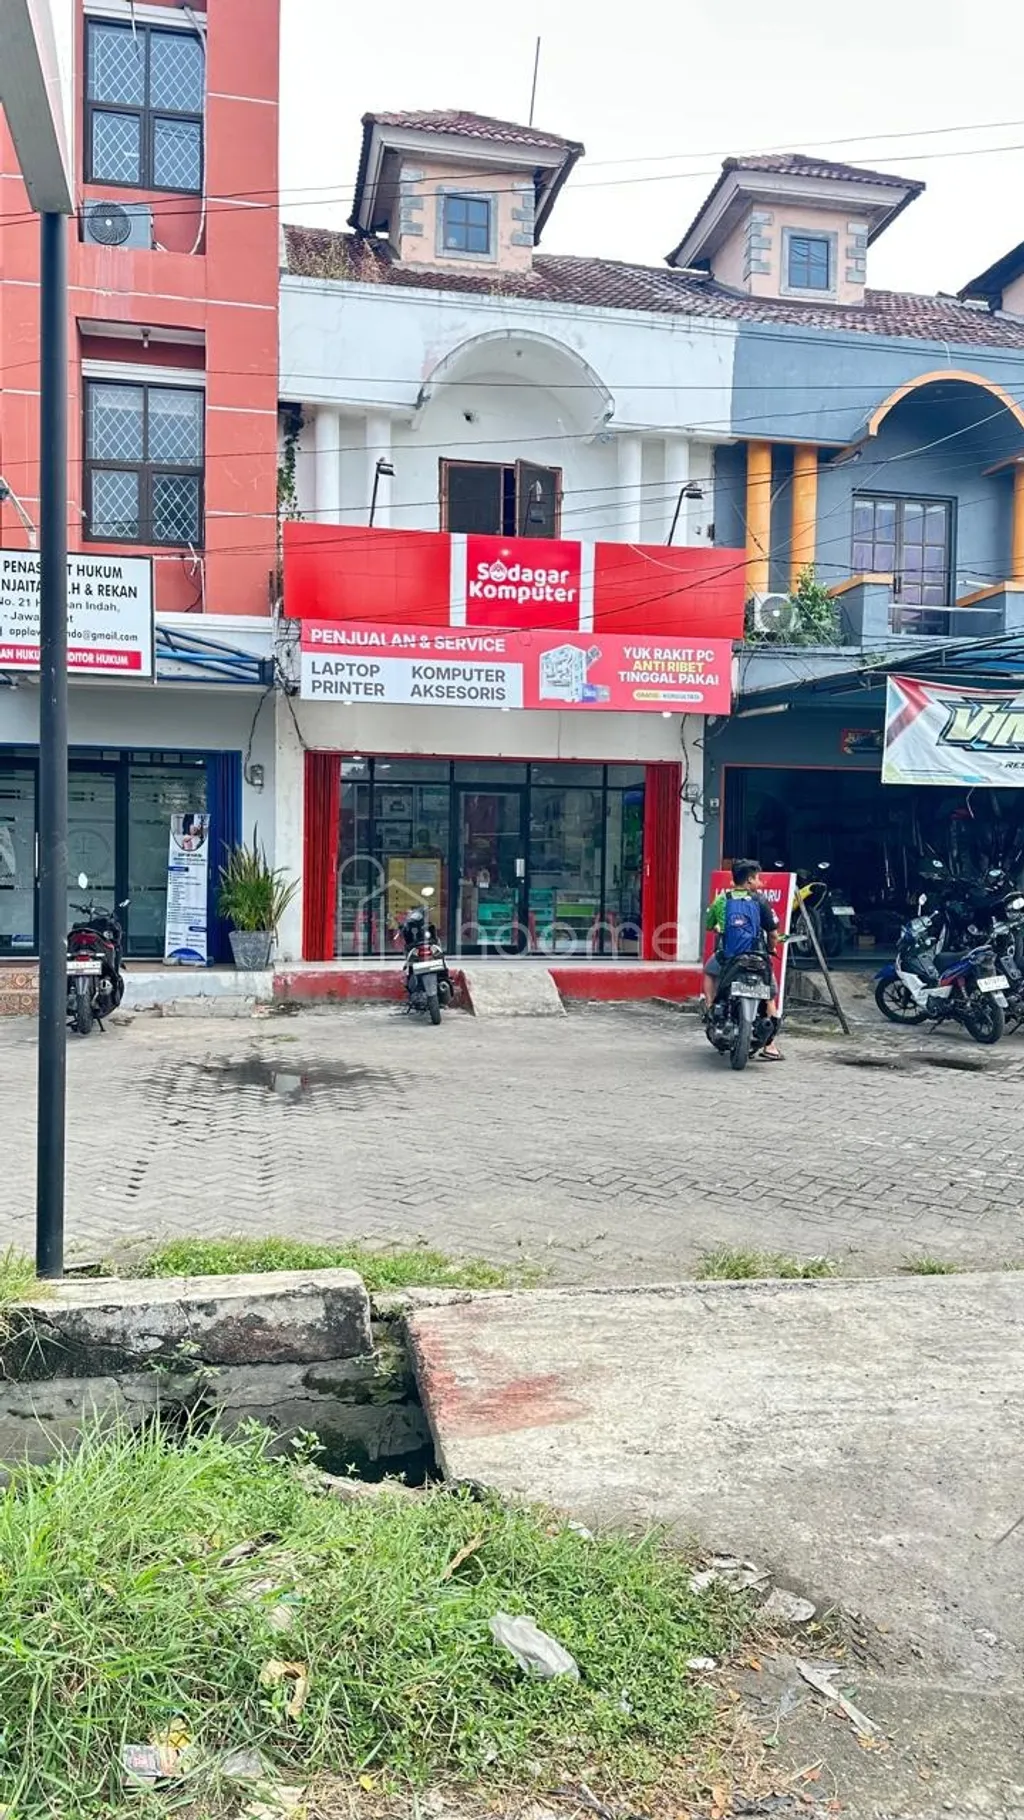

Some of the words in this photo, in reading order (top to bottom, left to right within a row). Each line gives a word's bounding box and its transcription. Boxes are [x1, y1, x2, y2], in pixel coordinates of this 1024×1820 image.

[3, 560, 73, 575] PENAST
[76, 564, 123, 578] HUKUM
[477, 558, 570, 587] Sodagar
[1, 579, 41, 592] NJAITA
[84, 583, 94, 595] &
[97, 584, 138, 598] REKAN
[469, 580, 577, 604] Komputer
[18, 597, 31, 607] 21
[85, 601, 121, 612] Indah,
[10, 612, 40, 621] Jawa
[310, 629, 413, 649] PENJUALAN
[419, 634, 431, 649] &
[434, 635, 505, 653] SERVICE
[15, 649, 41, 660] HUKU
[96, 653, 129, 666] HUKUM
[623, 647, 652, 659] YUK
[654, 648, 695, 661] RAKIT
[696, 649, 715, 662] PC
[311, 661, 381, 678] LAPTOP
[411, 665, 506, 683] KOMPUTER
[633, 660, 665, 671] ANTI
[667, 661, 705, 673] RIBET
[618, 671, 676, 684] TINGGAL
[678, 673, 720, 686] PAKAI
[311, 680, 385, 697] PRINTER
[410, 684, 506, 701] AKSESORIS
